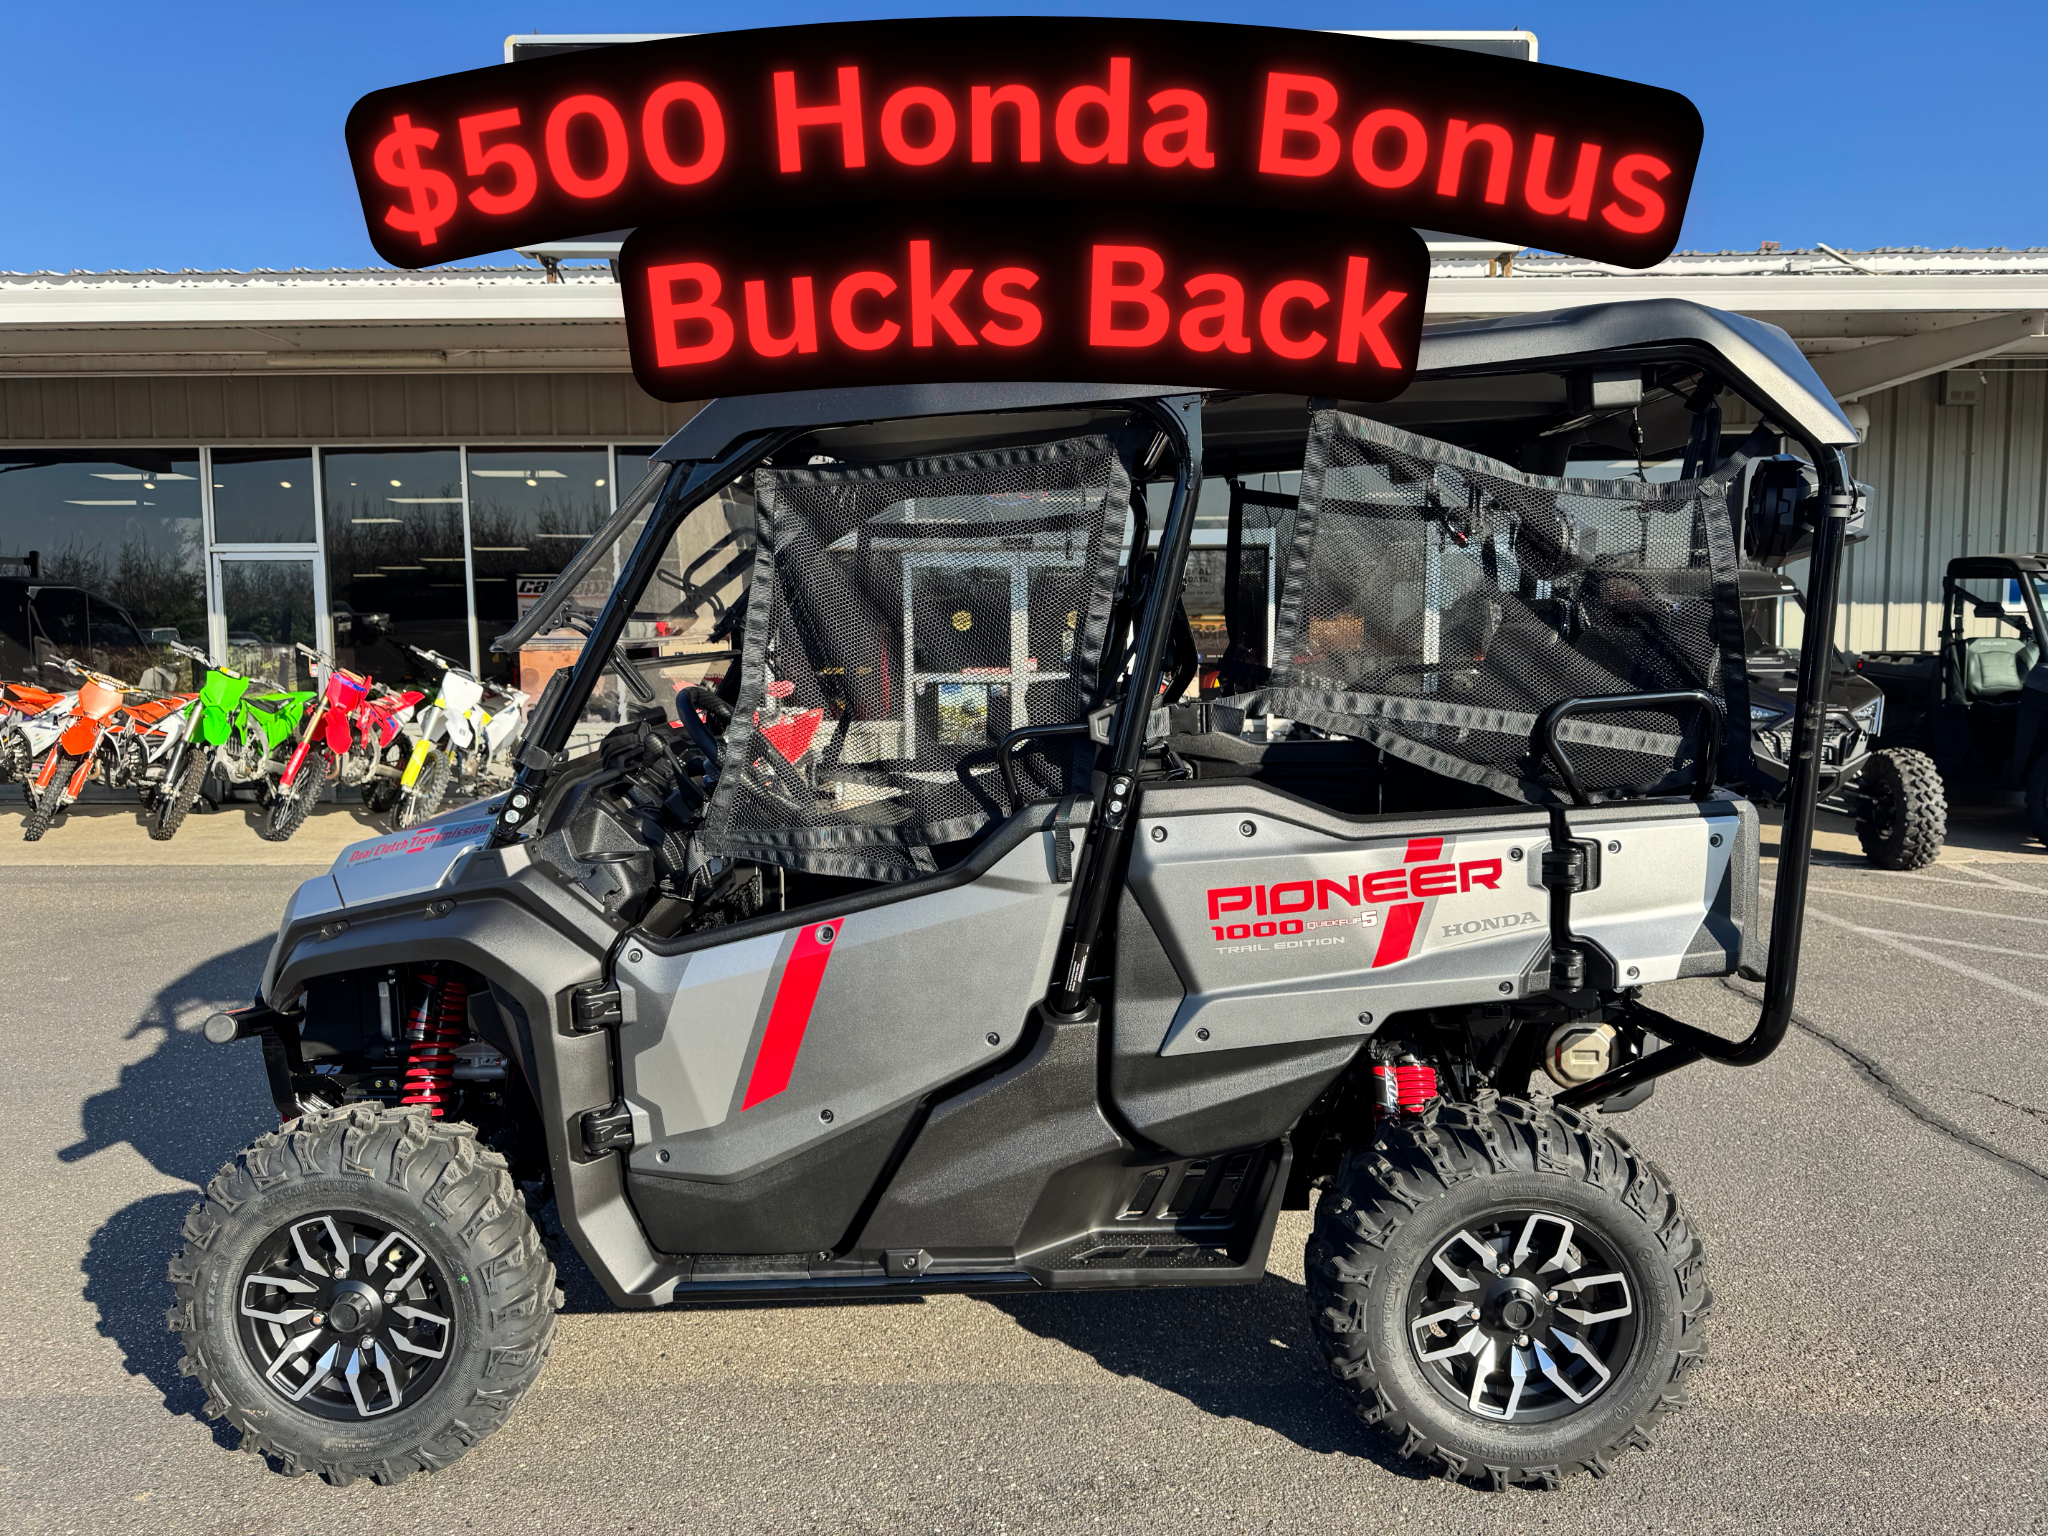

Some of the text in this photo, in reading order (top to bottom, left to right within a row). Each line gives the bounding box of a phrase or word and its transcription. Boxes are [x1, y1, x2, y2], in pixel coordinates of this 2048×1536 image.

[349, 847, 375, 862] Dual
[374, 839, 409, 857] Clutch
[409, 823, 490, 847] Transmission
[1206, 857, 1503, 921] PIONEER
[1211, 919, 1304, 941] 1000
[1441, 911, 1541, 938] HONDA
[1215, 936, 1346, 954] TRAIL EDITION
